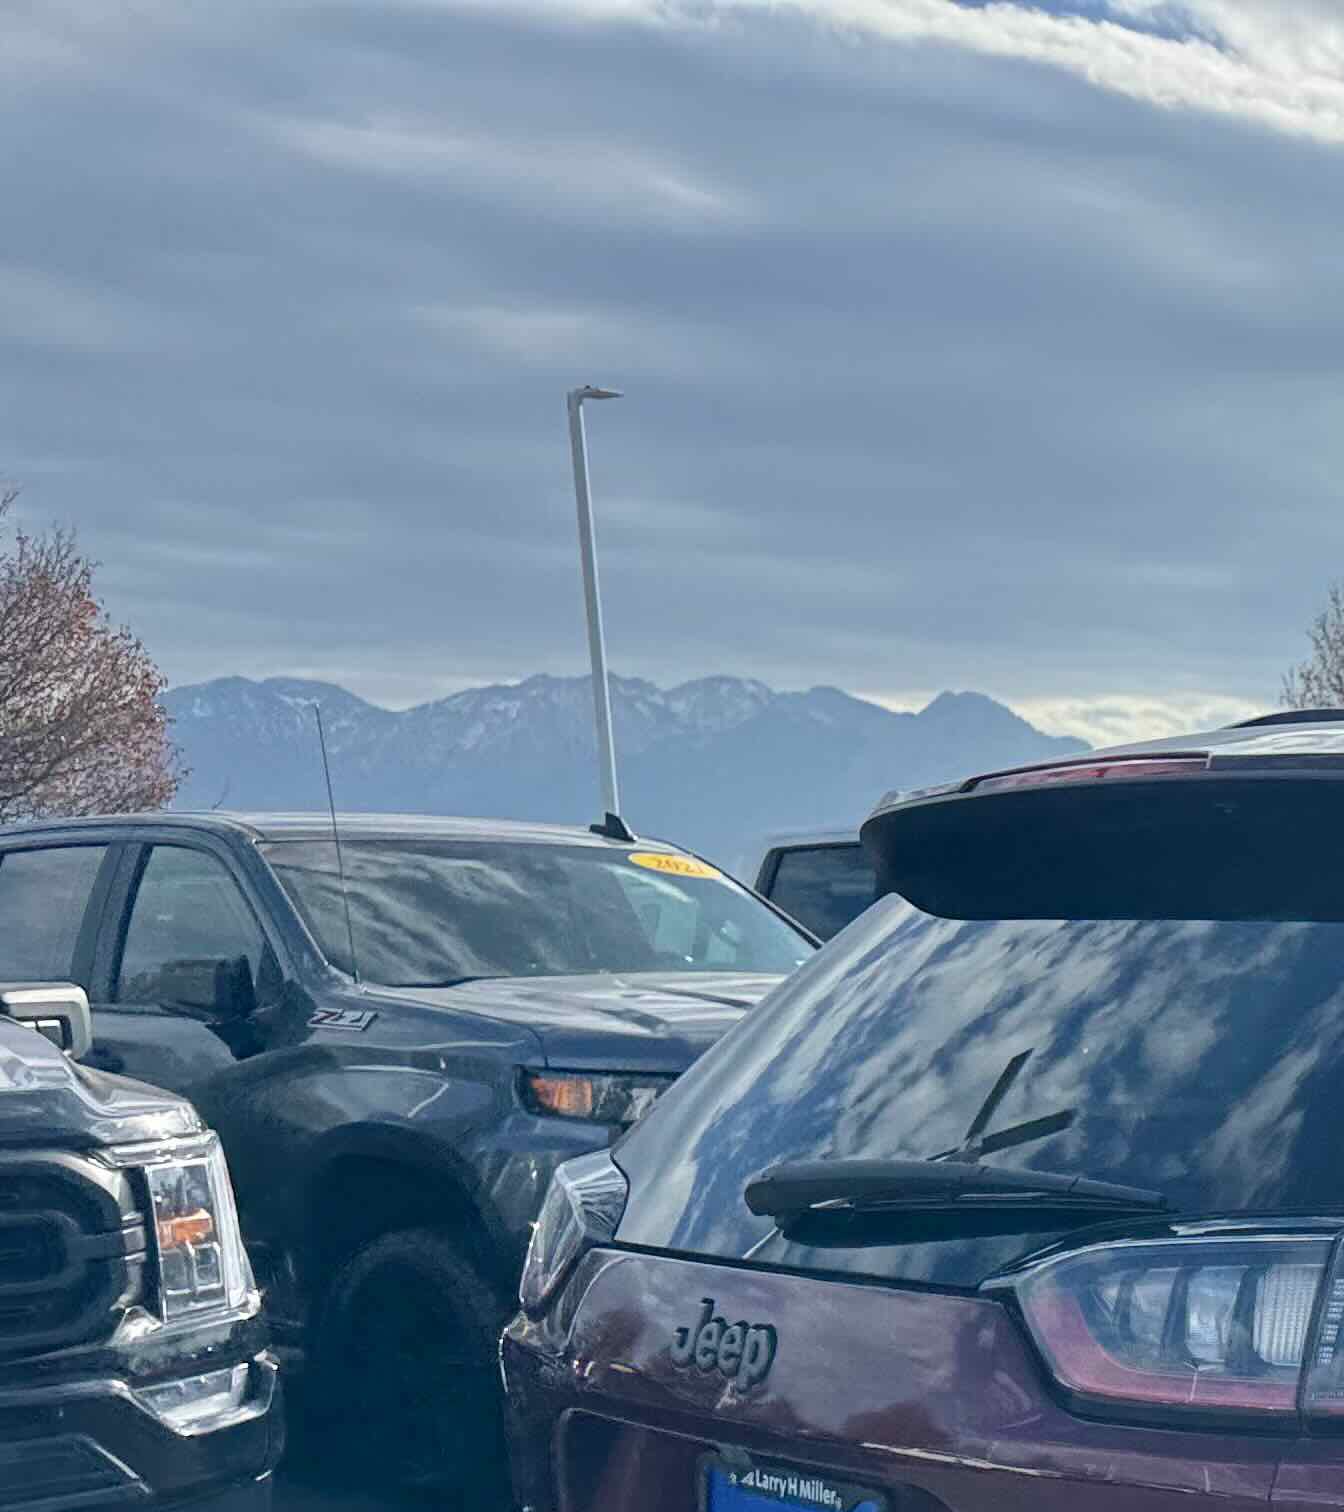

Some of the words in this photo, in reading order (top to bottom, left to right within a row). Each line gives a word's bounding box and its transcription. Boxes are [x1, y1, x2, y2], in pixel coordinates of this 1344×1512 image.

[669, 1297, 778, 1393] Jeep
[755, 1468, 787, 1498] Larry
[787, 1477, 798, 1497] H
[799, 1480, 837, 1505] Miller
